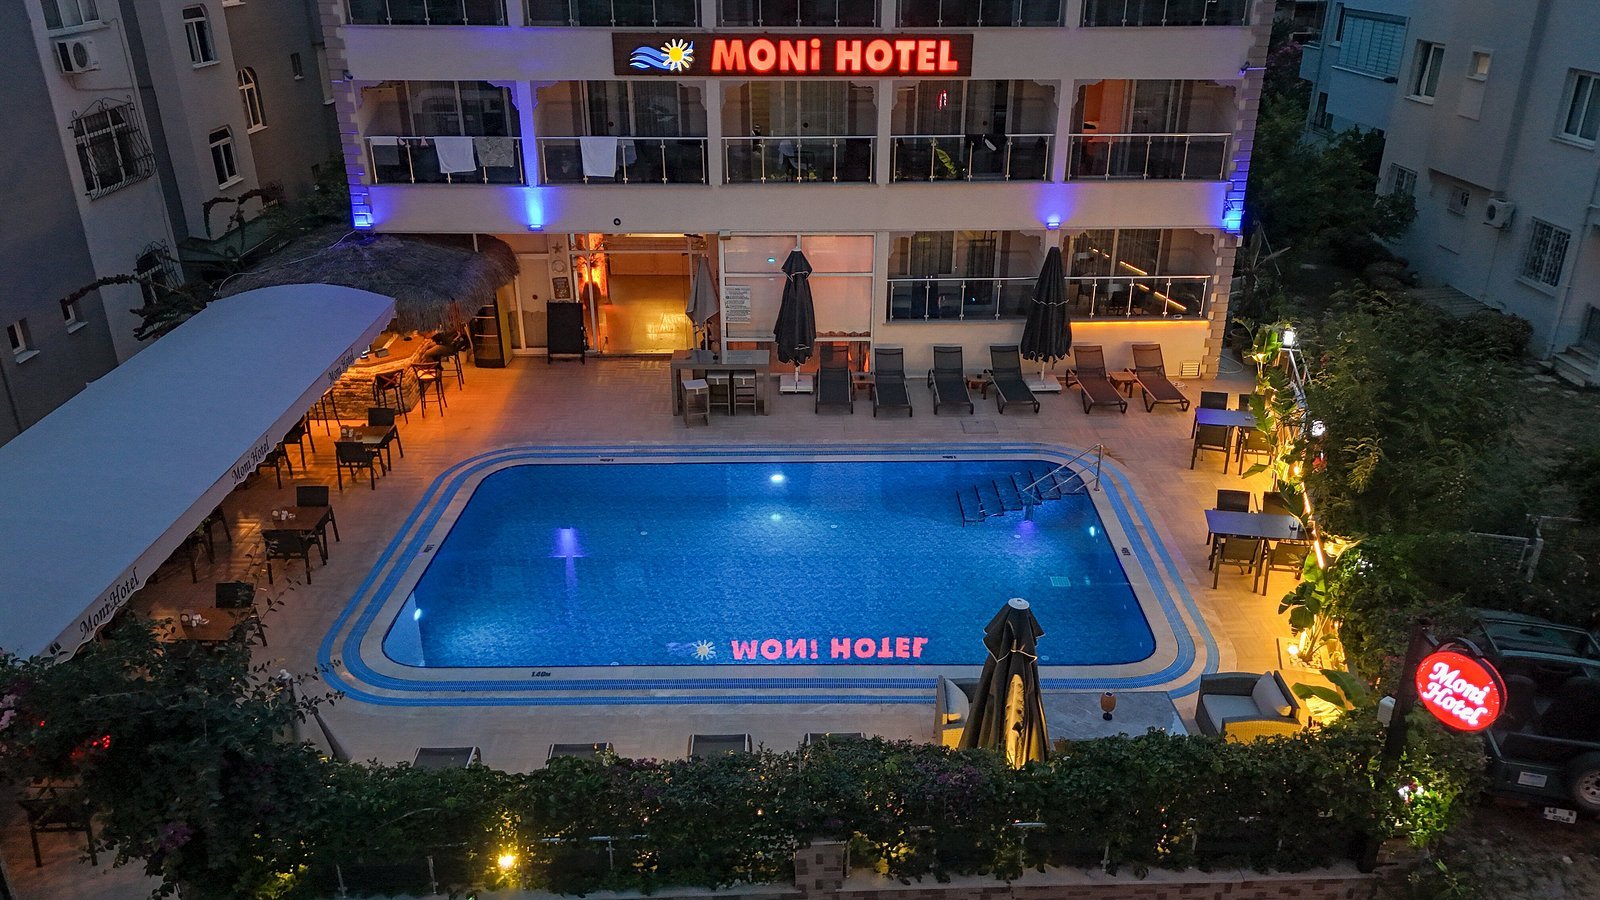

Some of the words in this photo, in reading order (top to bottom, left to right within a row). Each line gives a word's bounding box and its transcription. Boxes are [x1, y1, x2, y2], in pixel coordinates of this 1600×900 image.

[835, 38, 959, 72] HOTEL
[231, 455, 252, 485] Moni
[250, 434, 270, 467] Hotel
[80, 598, 111, 640] Moni
[109, 566, 140, 612] Hotel
[1422, 681, 1489, 726] Hotel
[1428, 661, 1491, 706] Moni
